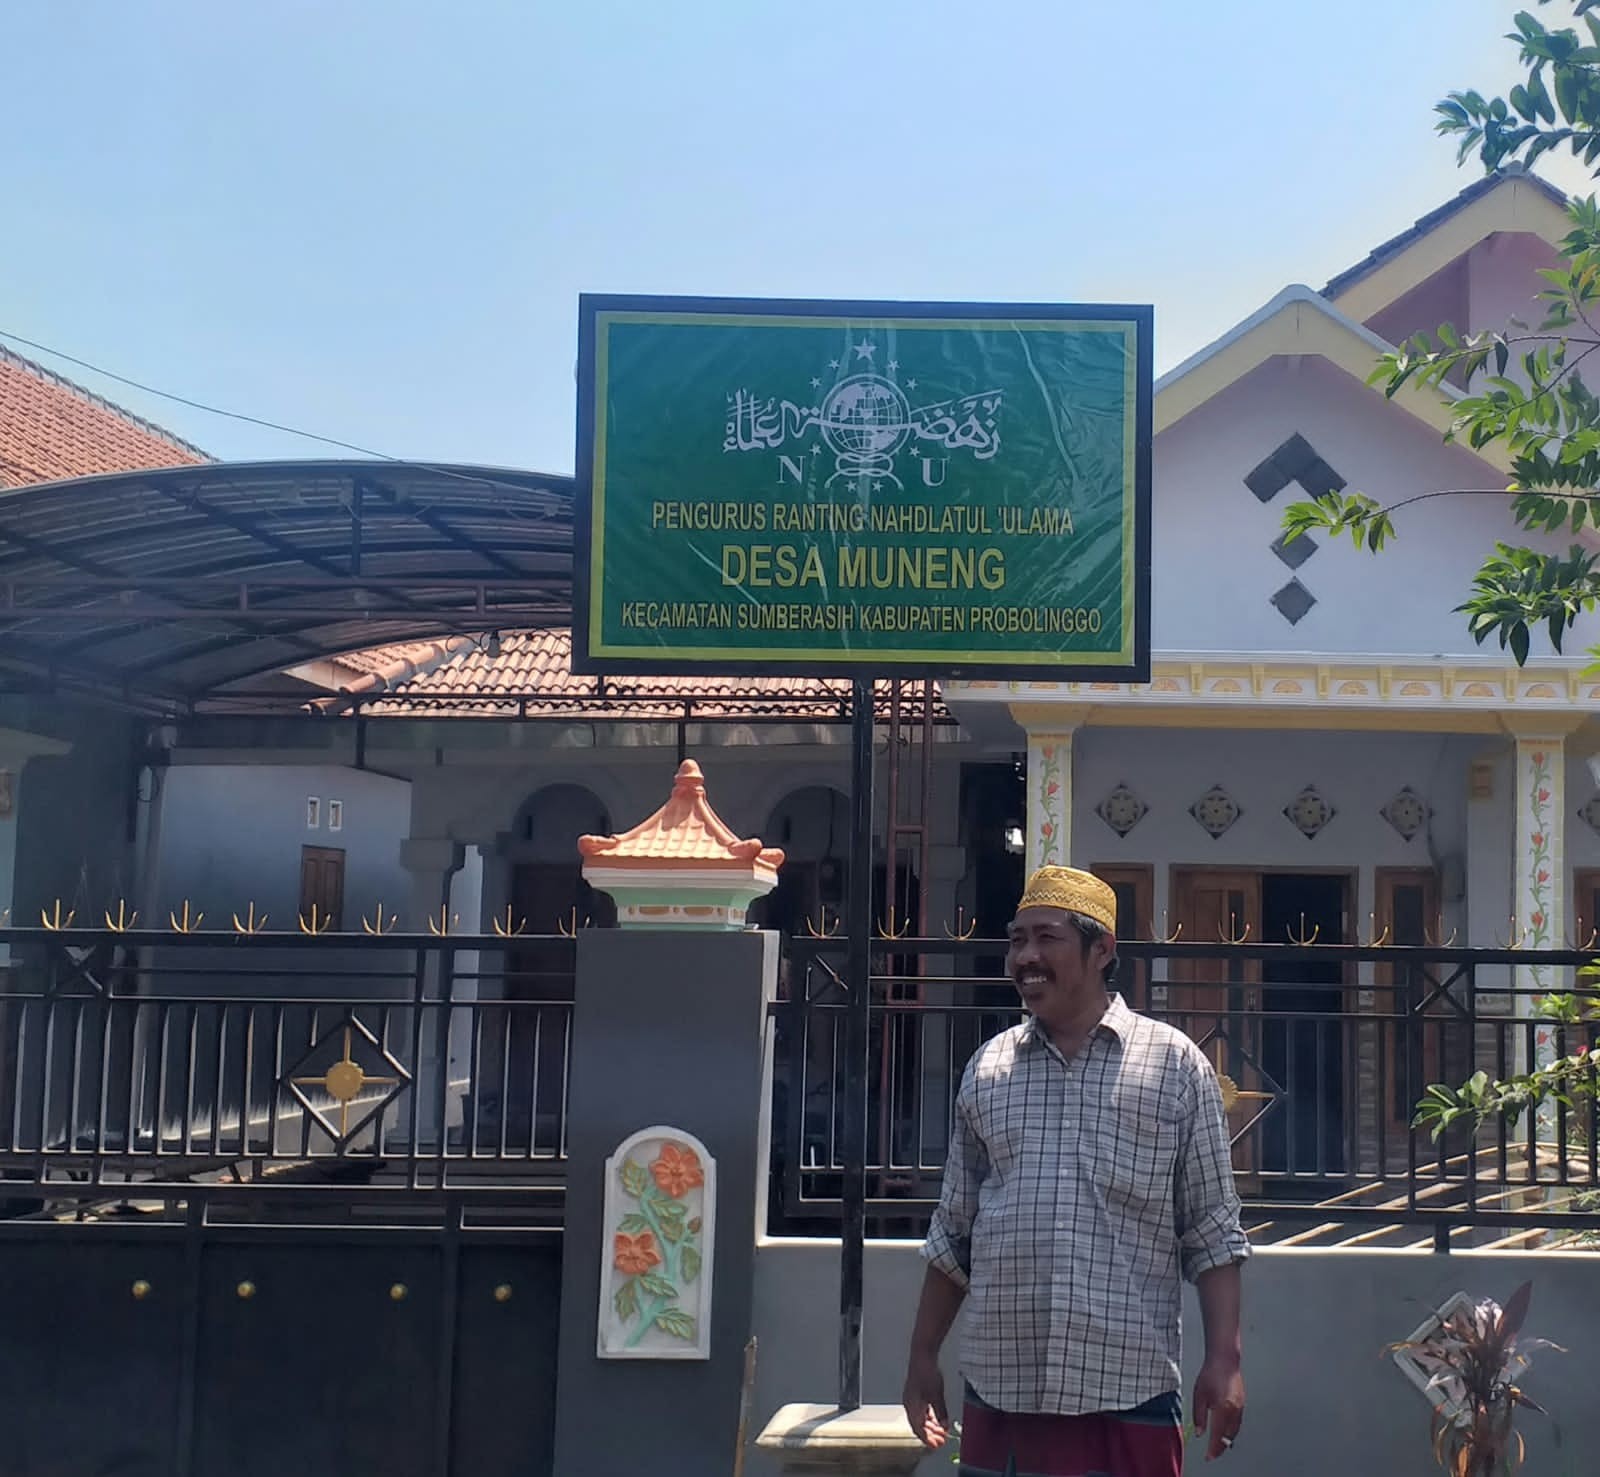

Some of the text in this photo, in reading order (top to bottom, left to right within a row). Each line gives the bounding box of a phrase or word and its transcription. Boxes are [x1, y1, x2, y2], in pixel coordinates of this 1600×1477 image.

[776, 455, 951, 487] N U
[652, 501, 767, 530] PENGURUS
[772, 503, 865, 532] RANTING
[870, 505, 993, 534] NAHDLATUL
[721, 544, 1006, 590] DESA MUNENG
[621, 601, 1101, 633] KECAMATAN SUMBERASIH KABUPATEN PROBOLINGGO
